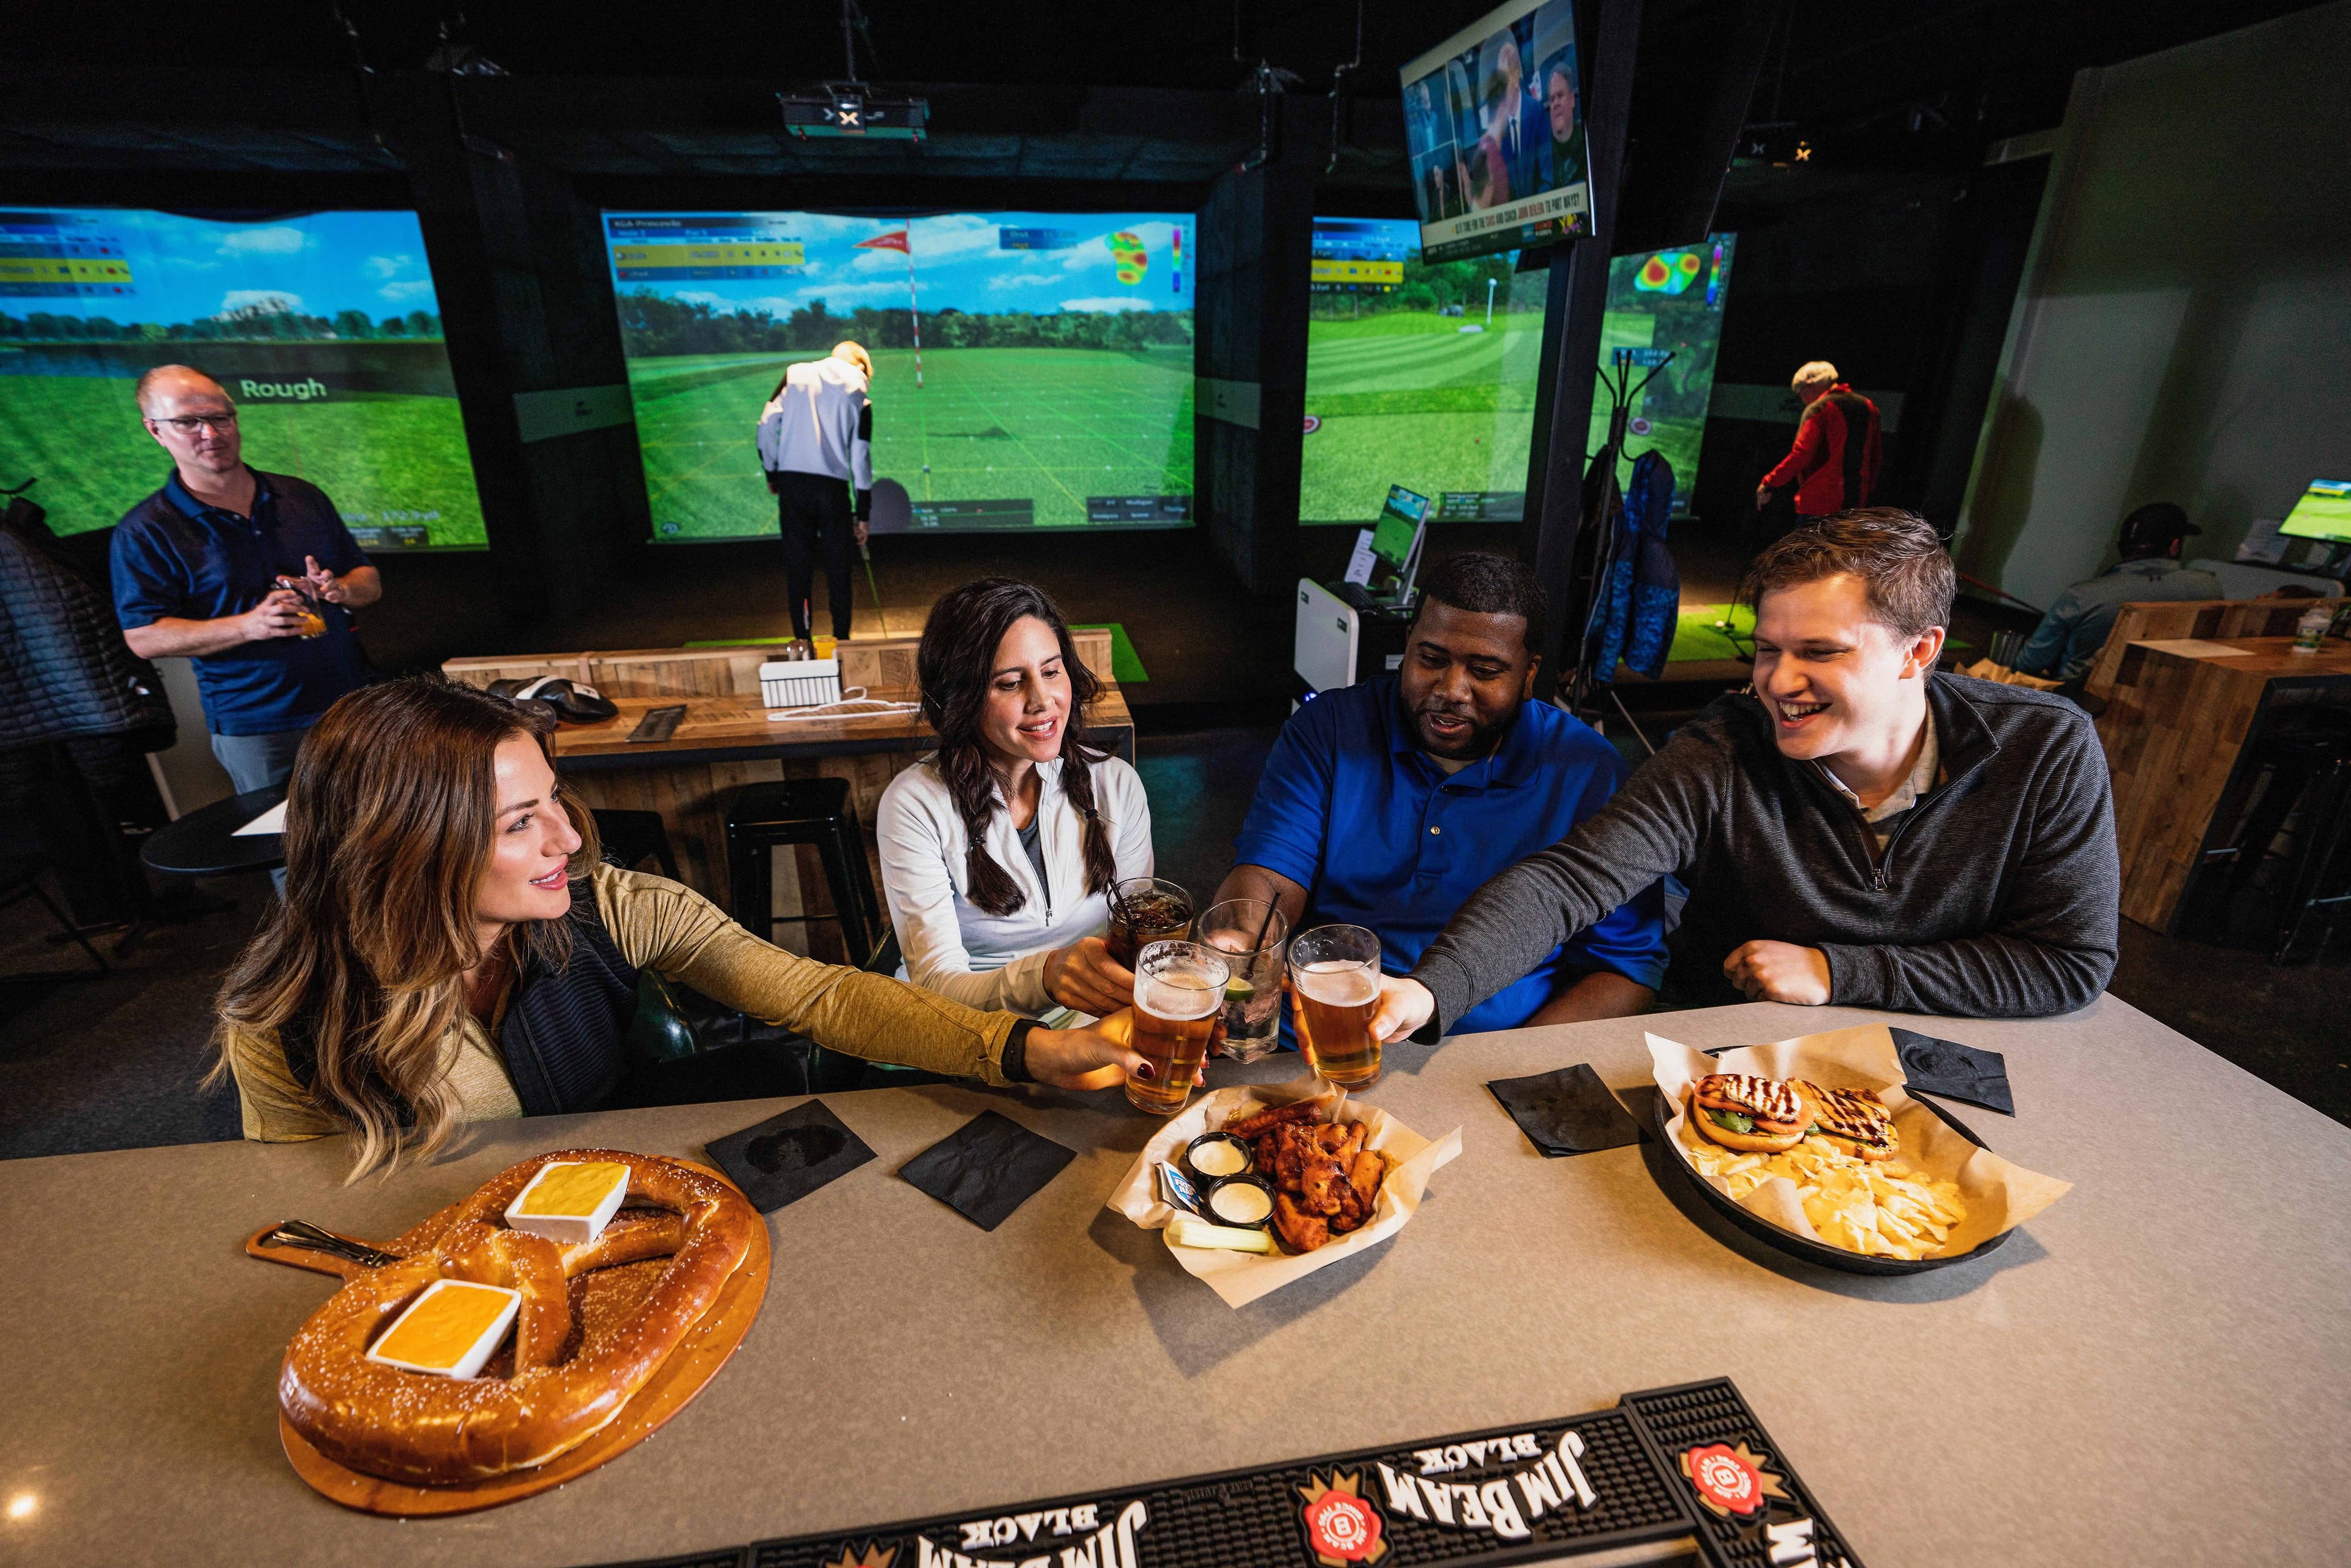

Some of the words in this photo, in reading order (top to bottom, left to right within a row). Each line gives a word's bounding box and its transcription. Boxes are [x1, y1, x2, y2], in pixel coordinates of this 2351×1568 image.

[240, 377, 327, 400] Rough
[1413, 1433, 1542, 1476] BLACK
[1515, 1430, 1597, 1518] JIM
[1376, 1461, 1531, 1539] BEAM
[959, 1504, 1100, 1551] BLACK
